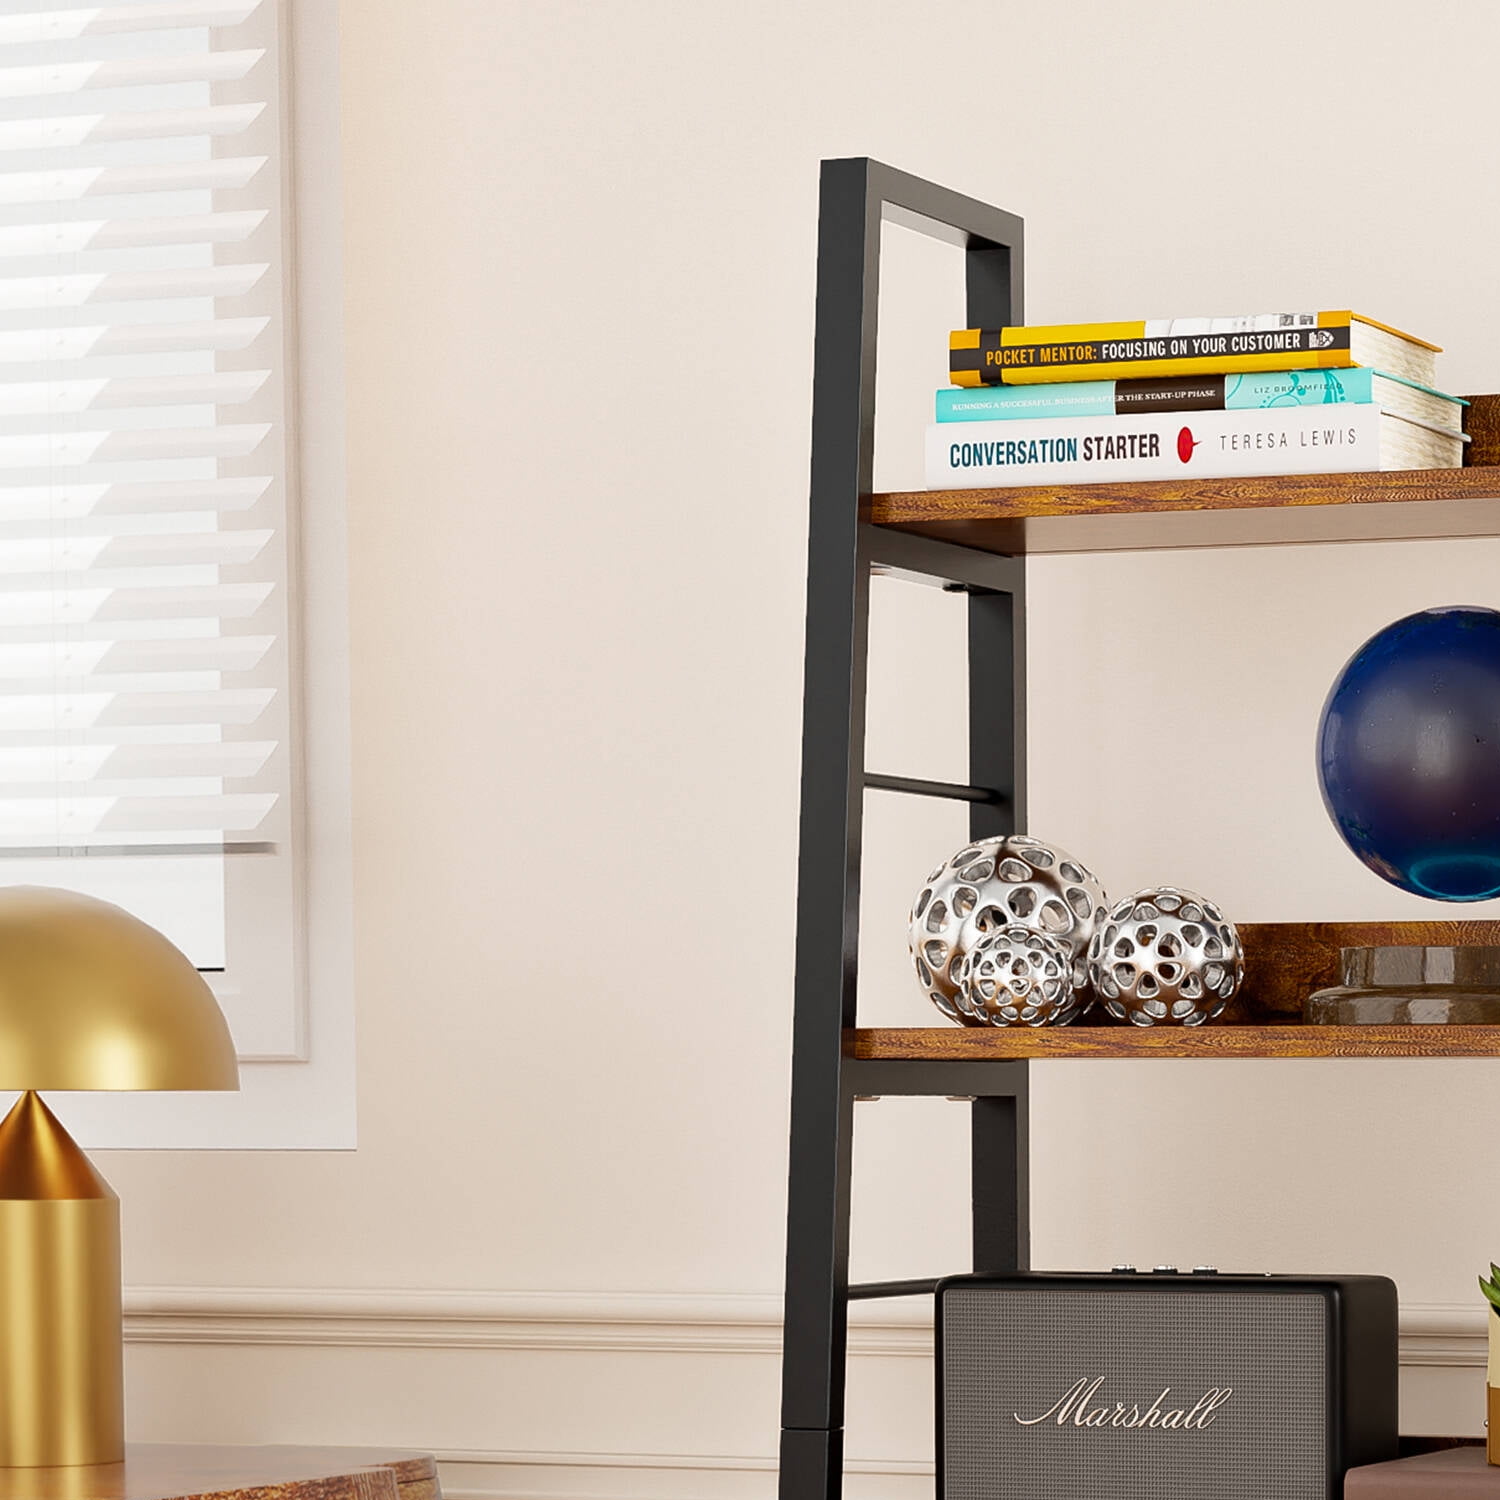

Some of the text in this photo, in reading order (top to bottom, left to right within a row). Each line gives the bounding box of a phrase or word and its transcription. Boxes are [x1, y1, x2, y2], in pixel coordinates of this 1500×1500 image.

[986, 332, 1301, 366] POCKET MENTOR: FOCUSING ON YOUR CUSTOMER
[951, 402, 992, 412] RUNNING
[1099, 394, 1126, 403] AFTER
[1126, 392, 1143, 401] THE
[1145, 391, 1187, 400] START-UP
[1188, 389, 1216, 399] PHASE
[1254, 386, 1270, 394] LIZ
[949, 432, 1160, 468] CONVERSATION STARTER
[1220, 428, 1357, 451] TERESA LEWIS
[1013, 1375, 1233, 1429] Marshall
